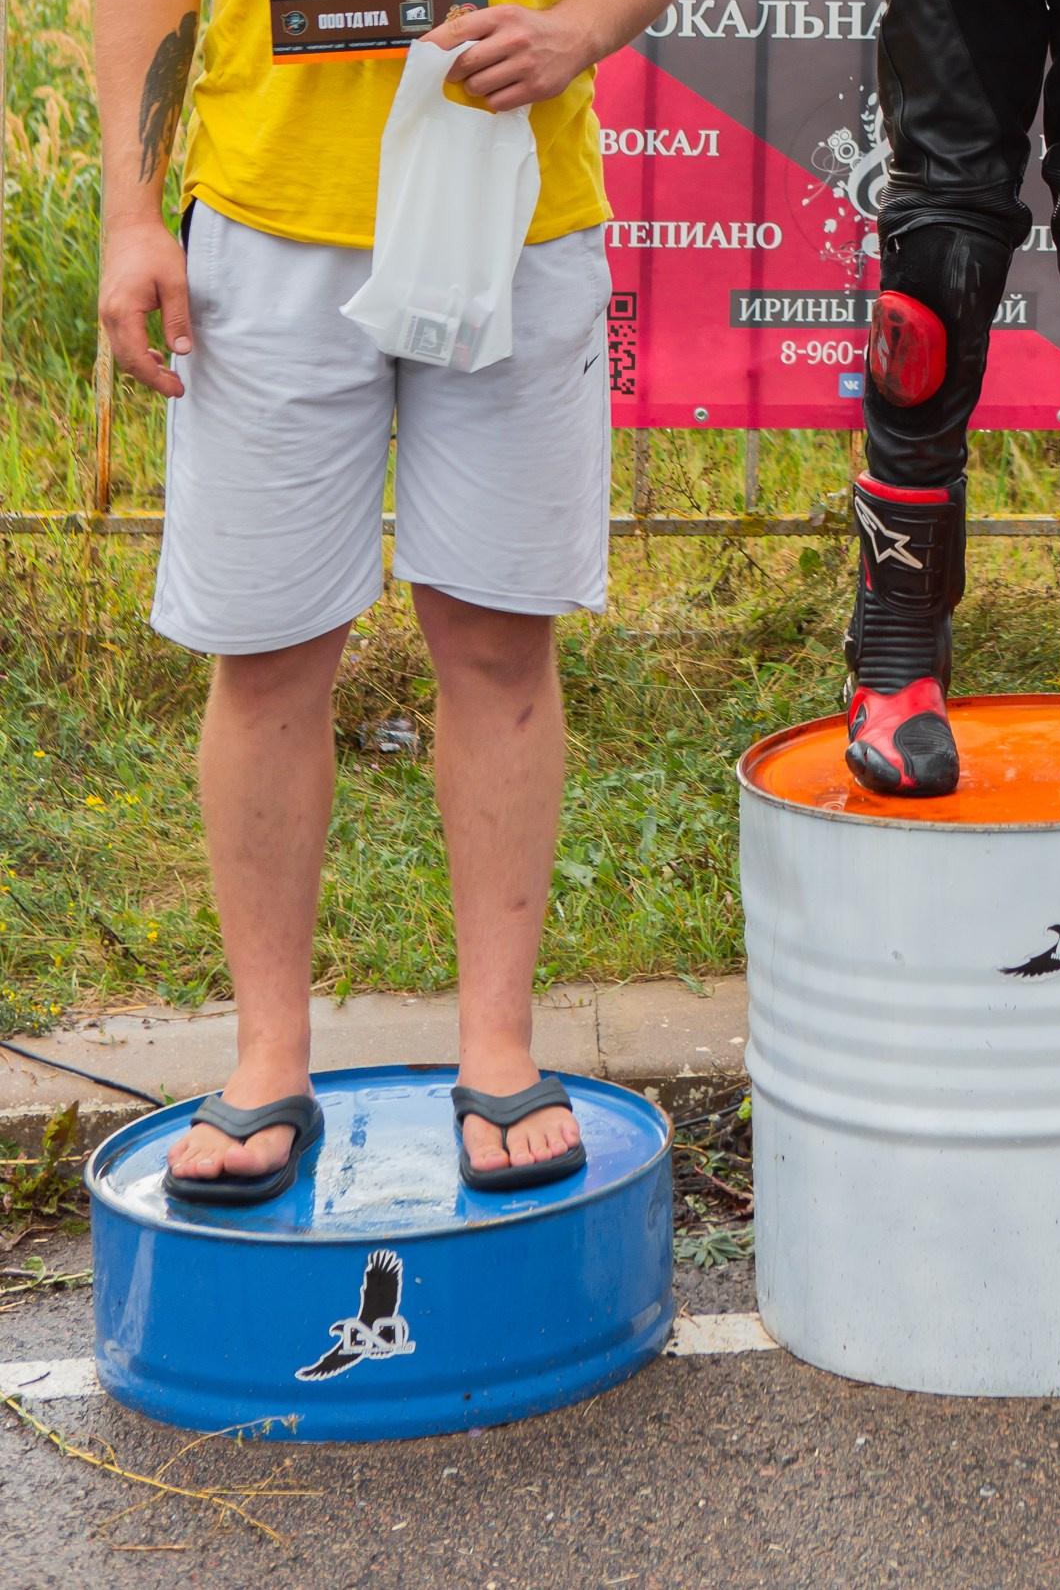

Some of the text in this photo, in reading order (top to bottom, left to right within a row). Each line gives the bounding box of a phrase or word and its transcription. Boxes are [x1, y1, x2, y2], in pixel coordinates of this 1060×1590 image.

[318, 11, 389, 29] ООО ТД ИТА
[644, 0, 888, 39] ОКАЛЬНА
[599, 129, 719, 156] ВОКАЛ
[605, 221, 782, 249] ТЕПИАНО
[739, 298, 855, 323] ИРИНЫ
[780, 340, 867, 365] 8-960-
